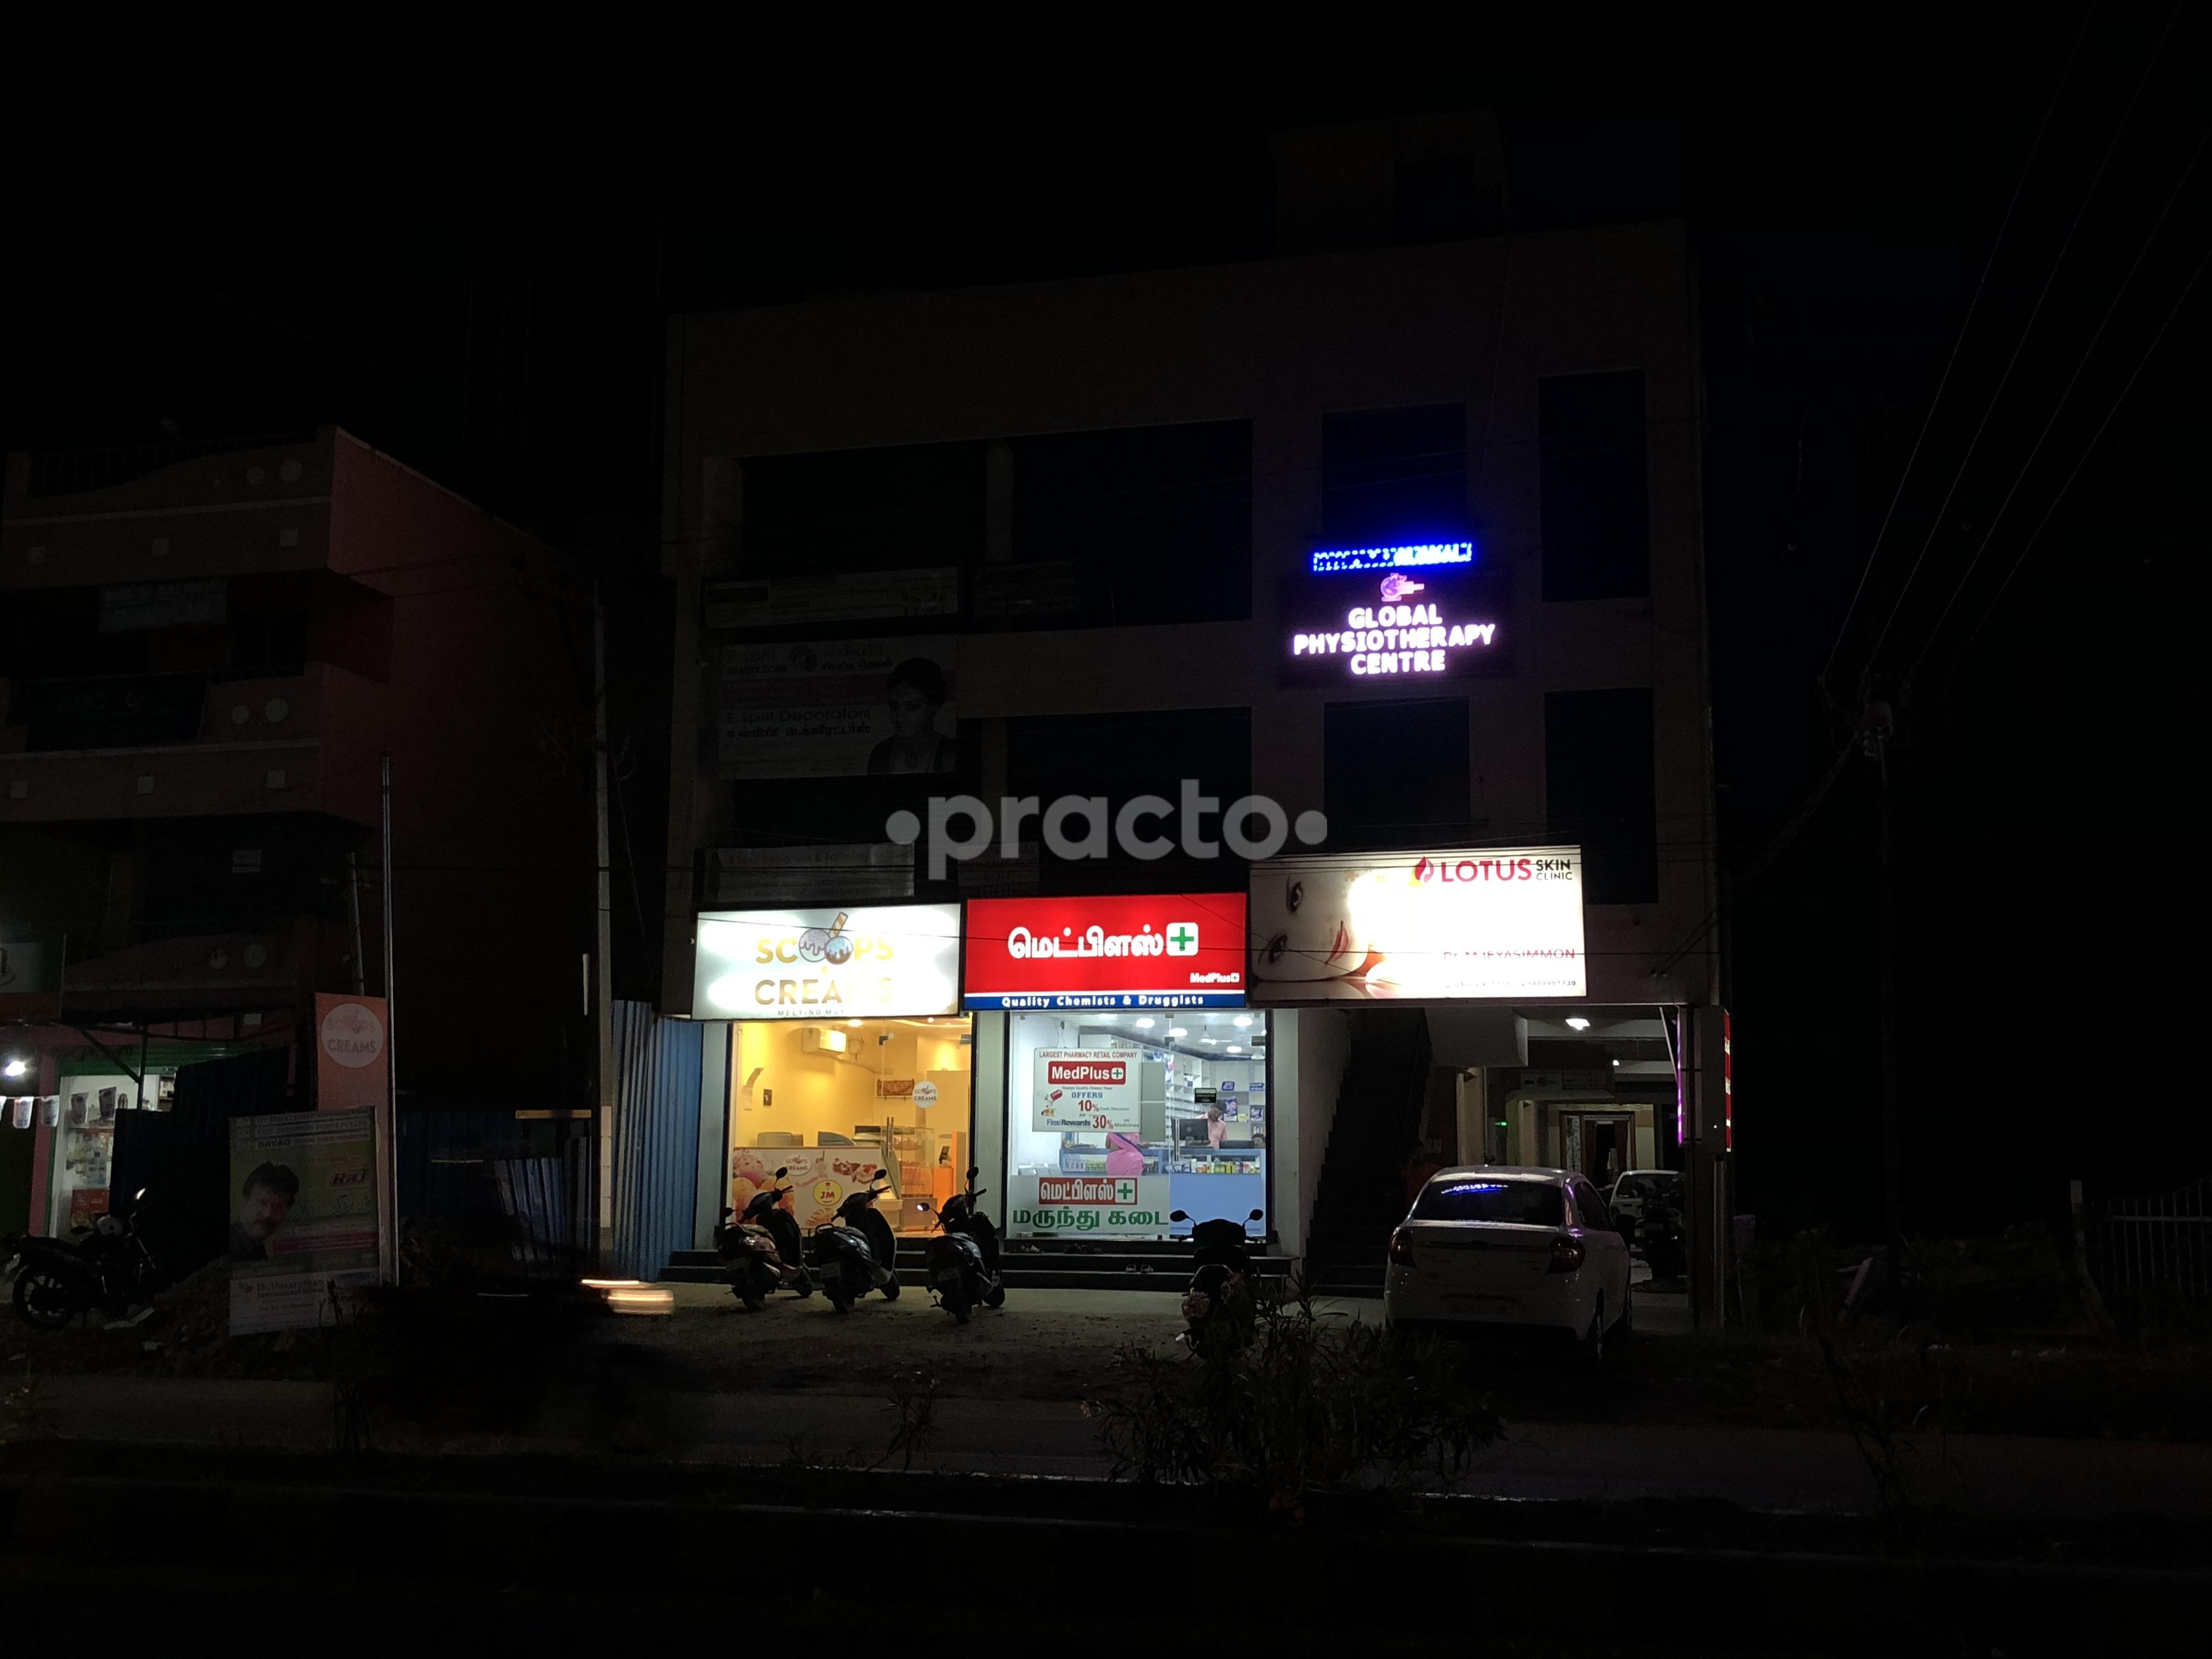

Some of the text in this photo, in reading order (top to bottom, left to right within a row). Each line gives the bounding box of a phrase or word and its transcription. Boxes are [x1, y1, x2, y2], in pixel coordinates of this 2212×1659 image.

[1348, 604, 1442, 629] GLOBAL
[1294, 624, 1496, 655] PHYSIOTHERAPY
[1351, 650, 1446, 674] CENTRE
[779, 708, 871, 722] Decorators
[1441, 859, 1571, 882] LOTUS SKIN
[1536, 872, 1572, 881] CLINIC
[1008, 924, 1164, 959] மெட்பிளஸ்
[1189, 972, 1231, 983] MedPlus
[755, 977, 894, 1005] CREAS
[1001, 994, 1204, 1008] Quality Chemists & Druggists
[329, 1039, 377, 1053] CREAMS
[1052, 1066, 1110, 1080] MedPlus
[1078, 1100, 1099, 1112] 10%
[1093, 1115, 1114, 1129] 30%
[820, 1191, 835, 1199] JM
[1041, 1178, 1114, 1201] மெட்பிளஸ்
[1013, 1205, 1169, 1231] மருந்து கடை
